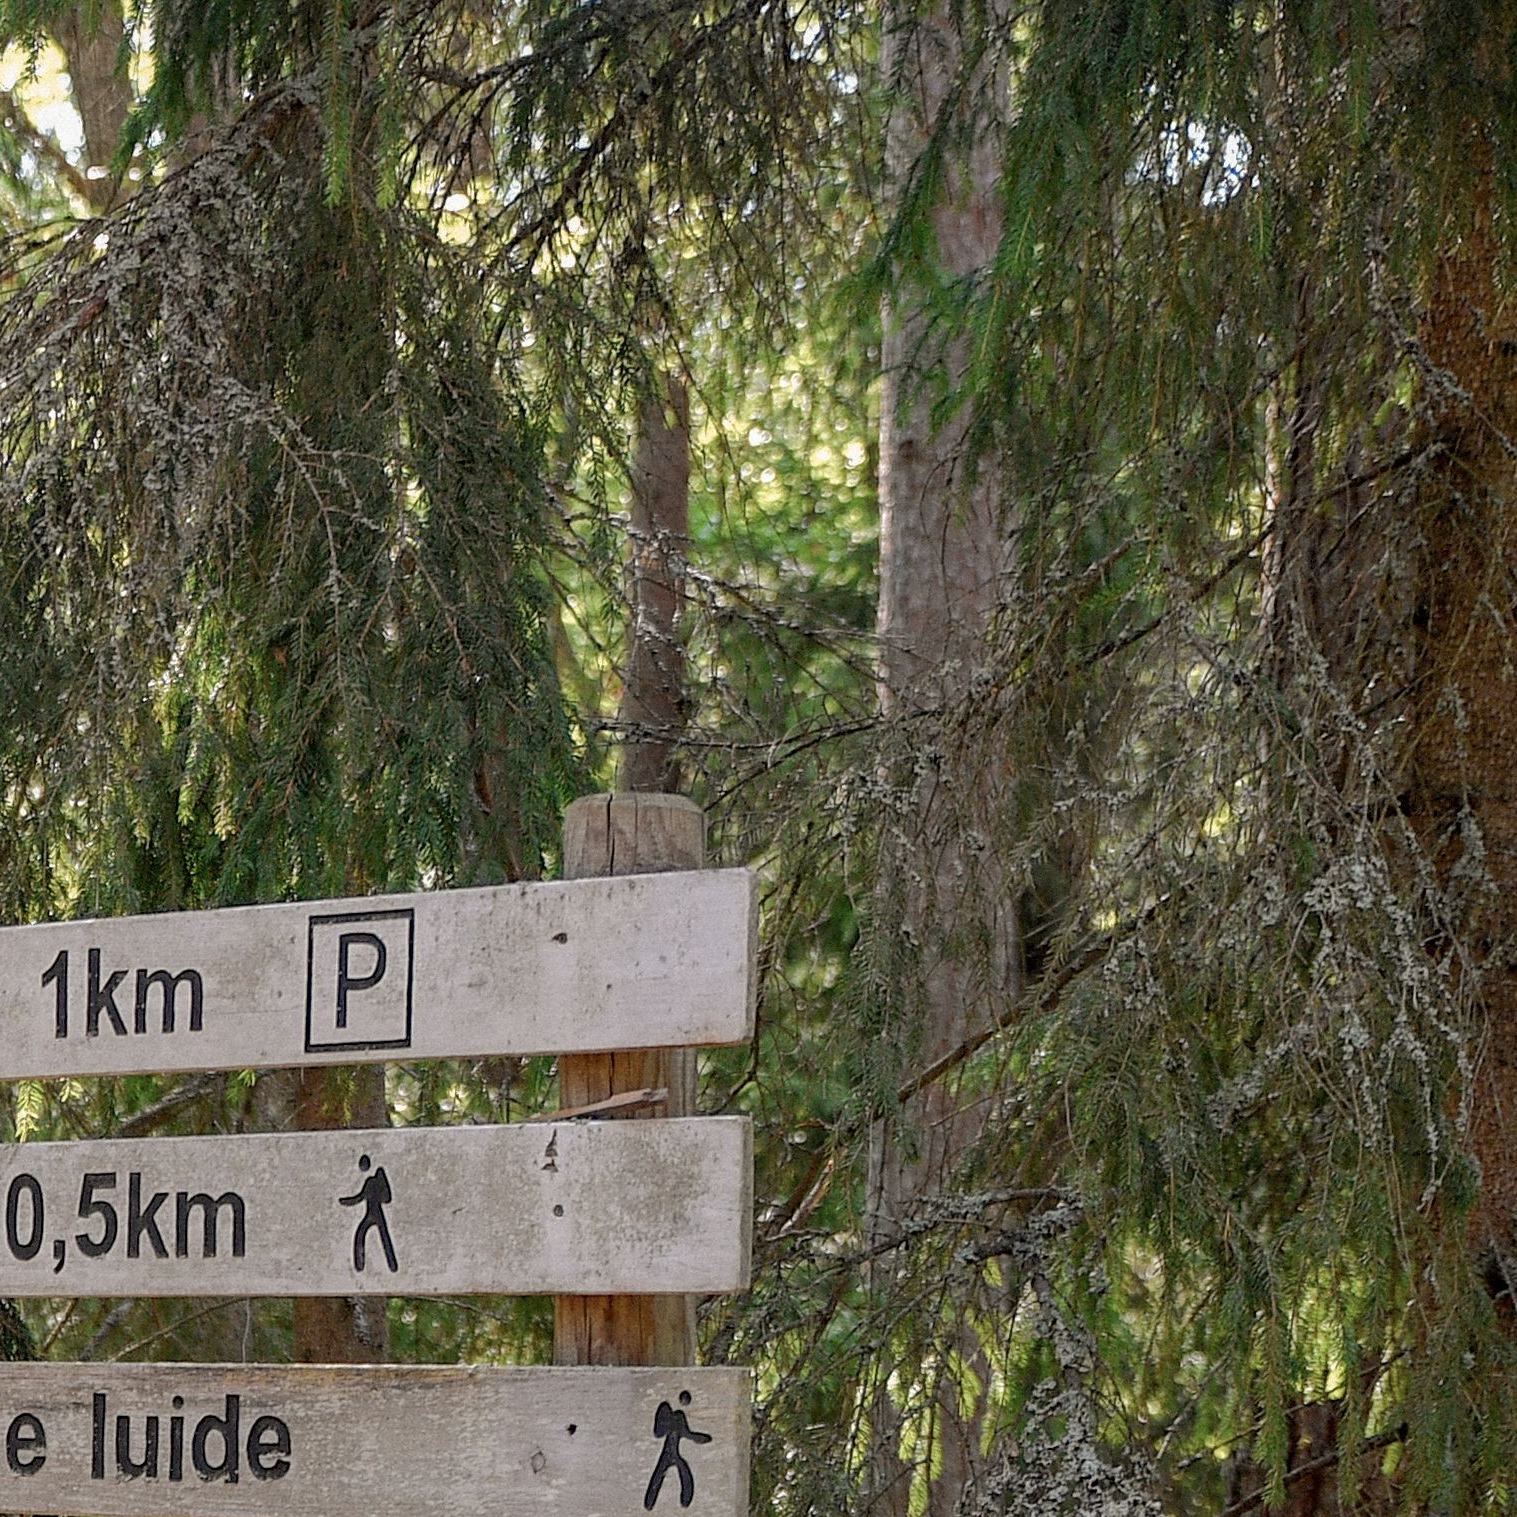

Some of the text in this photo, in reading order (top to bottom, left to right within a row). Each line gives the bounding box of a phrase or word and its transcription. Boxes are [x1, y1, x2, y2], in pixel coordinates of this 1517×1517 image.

[41, 948, 204, 1039] 1km
[335, 932, 387, 1029] P
[5, 1172, 247, 1274] 0,5km
[91, 1392, 293, 1484] luide
